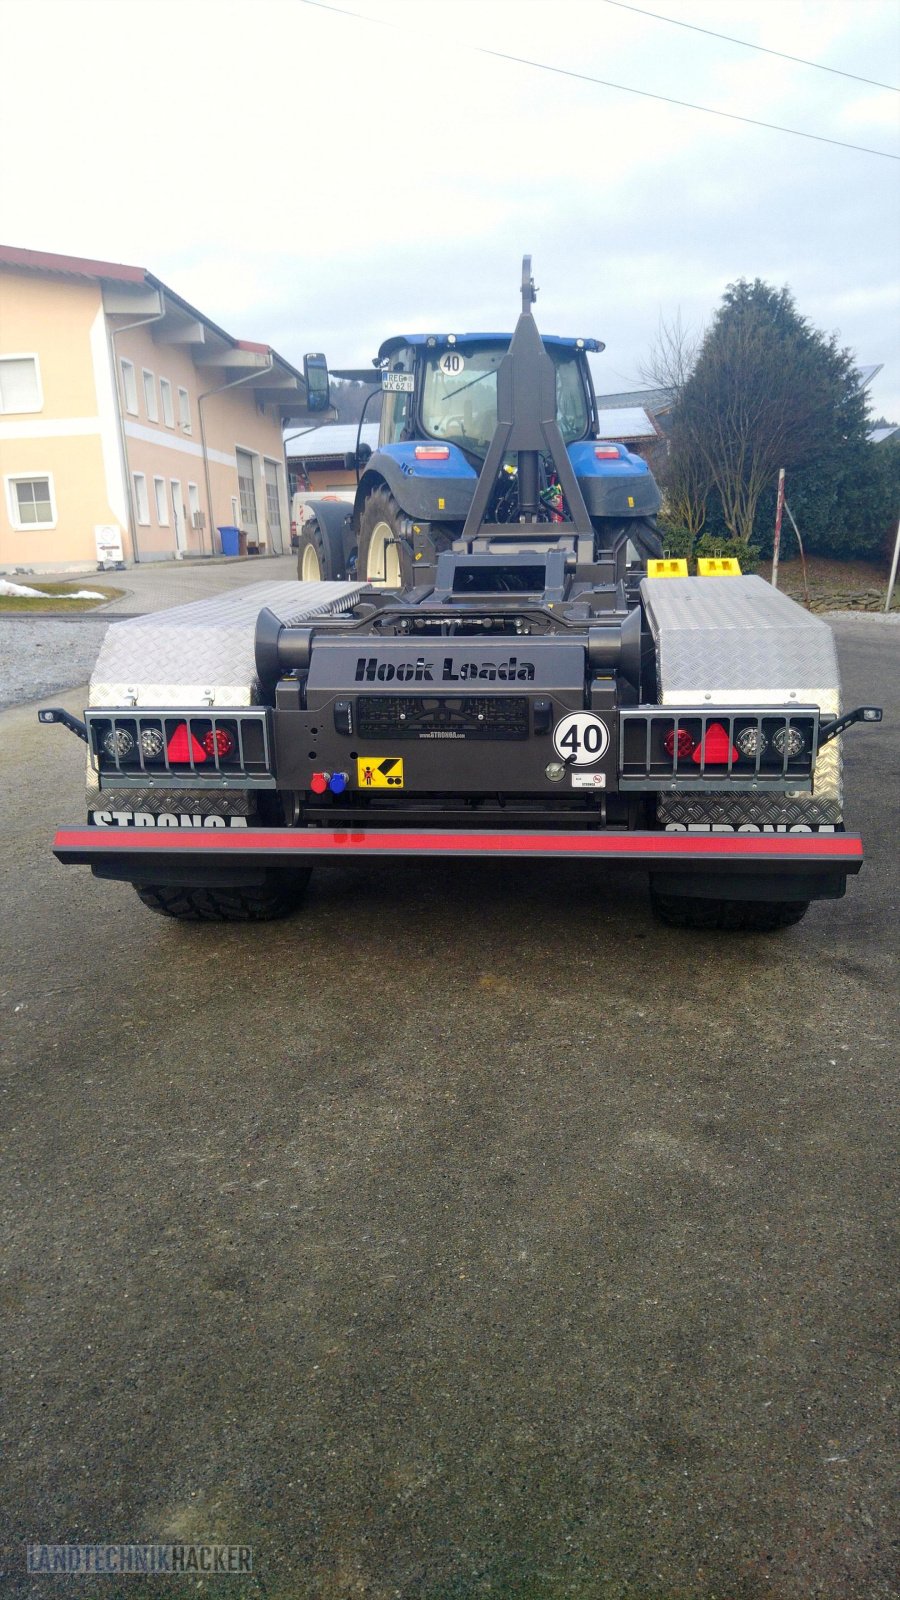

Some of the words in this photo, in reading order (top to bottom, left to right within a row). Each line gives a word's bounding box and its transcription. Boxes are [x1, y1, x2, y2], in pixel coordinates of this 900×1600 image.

[444, 356, 460, 371] 40
[388, 374, 404, 382] REG
[355, 657, 434, 681] Hook
[442, 657, 536, 681] Loada
[560, 724, 602, 753] 40
